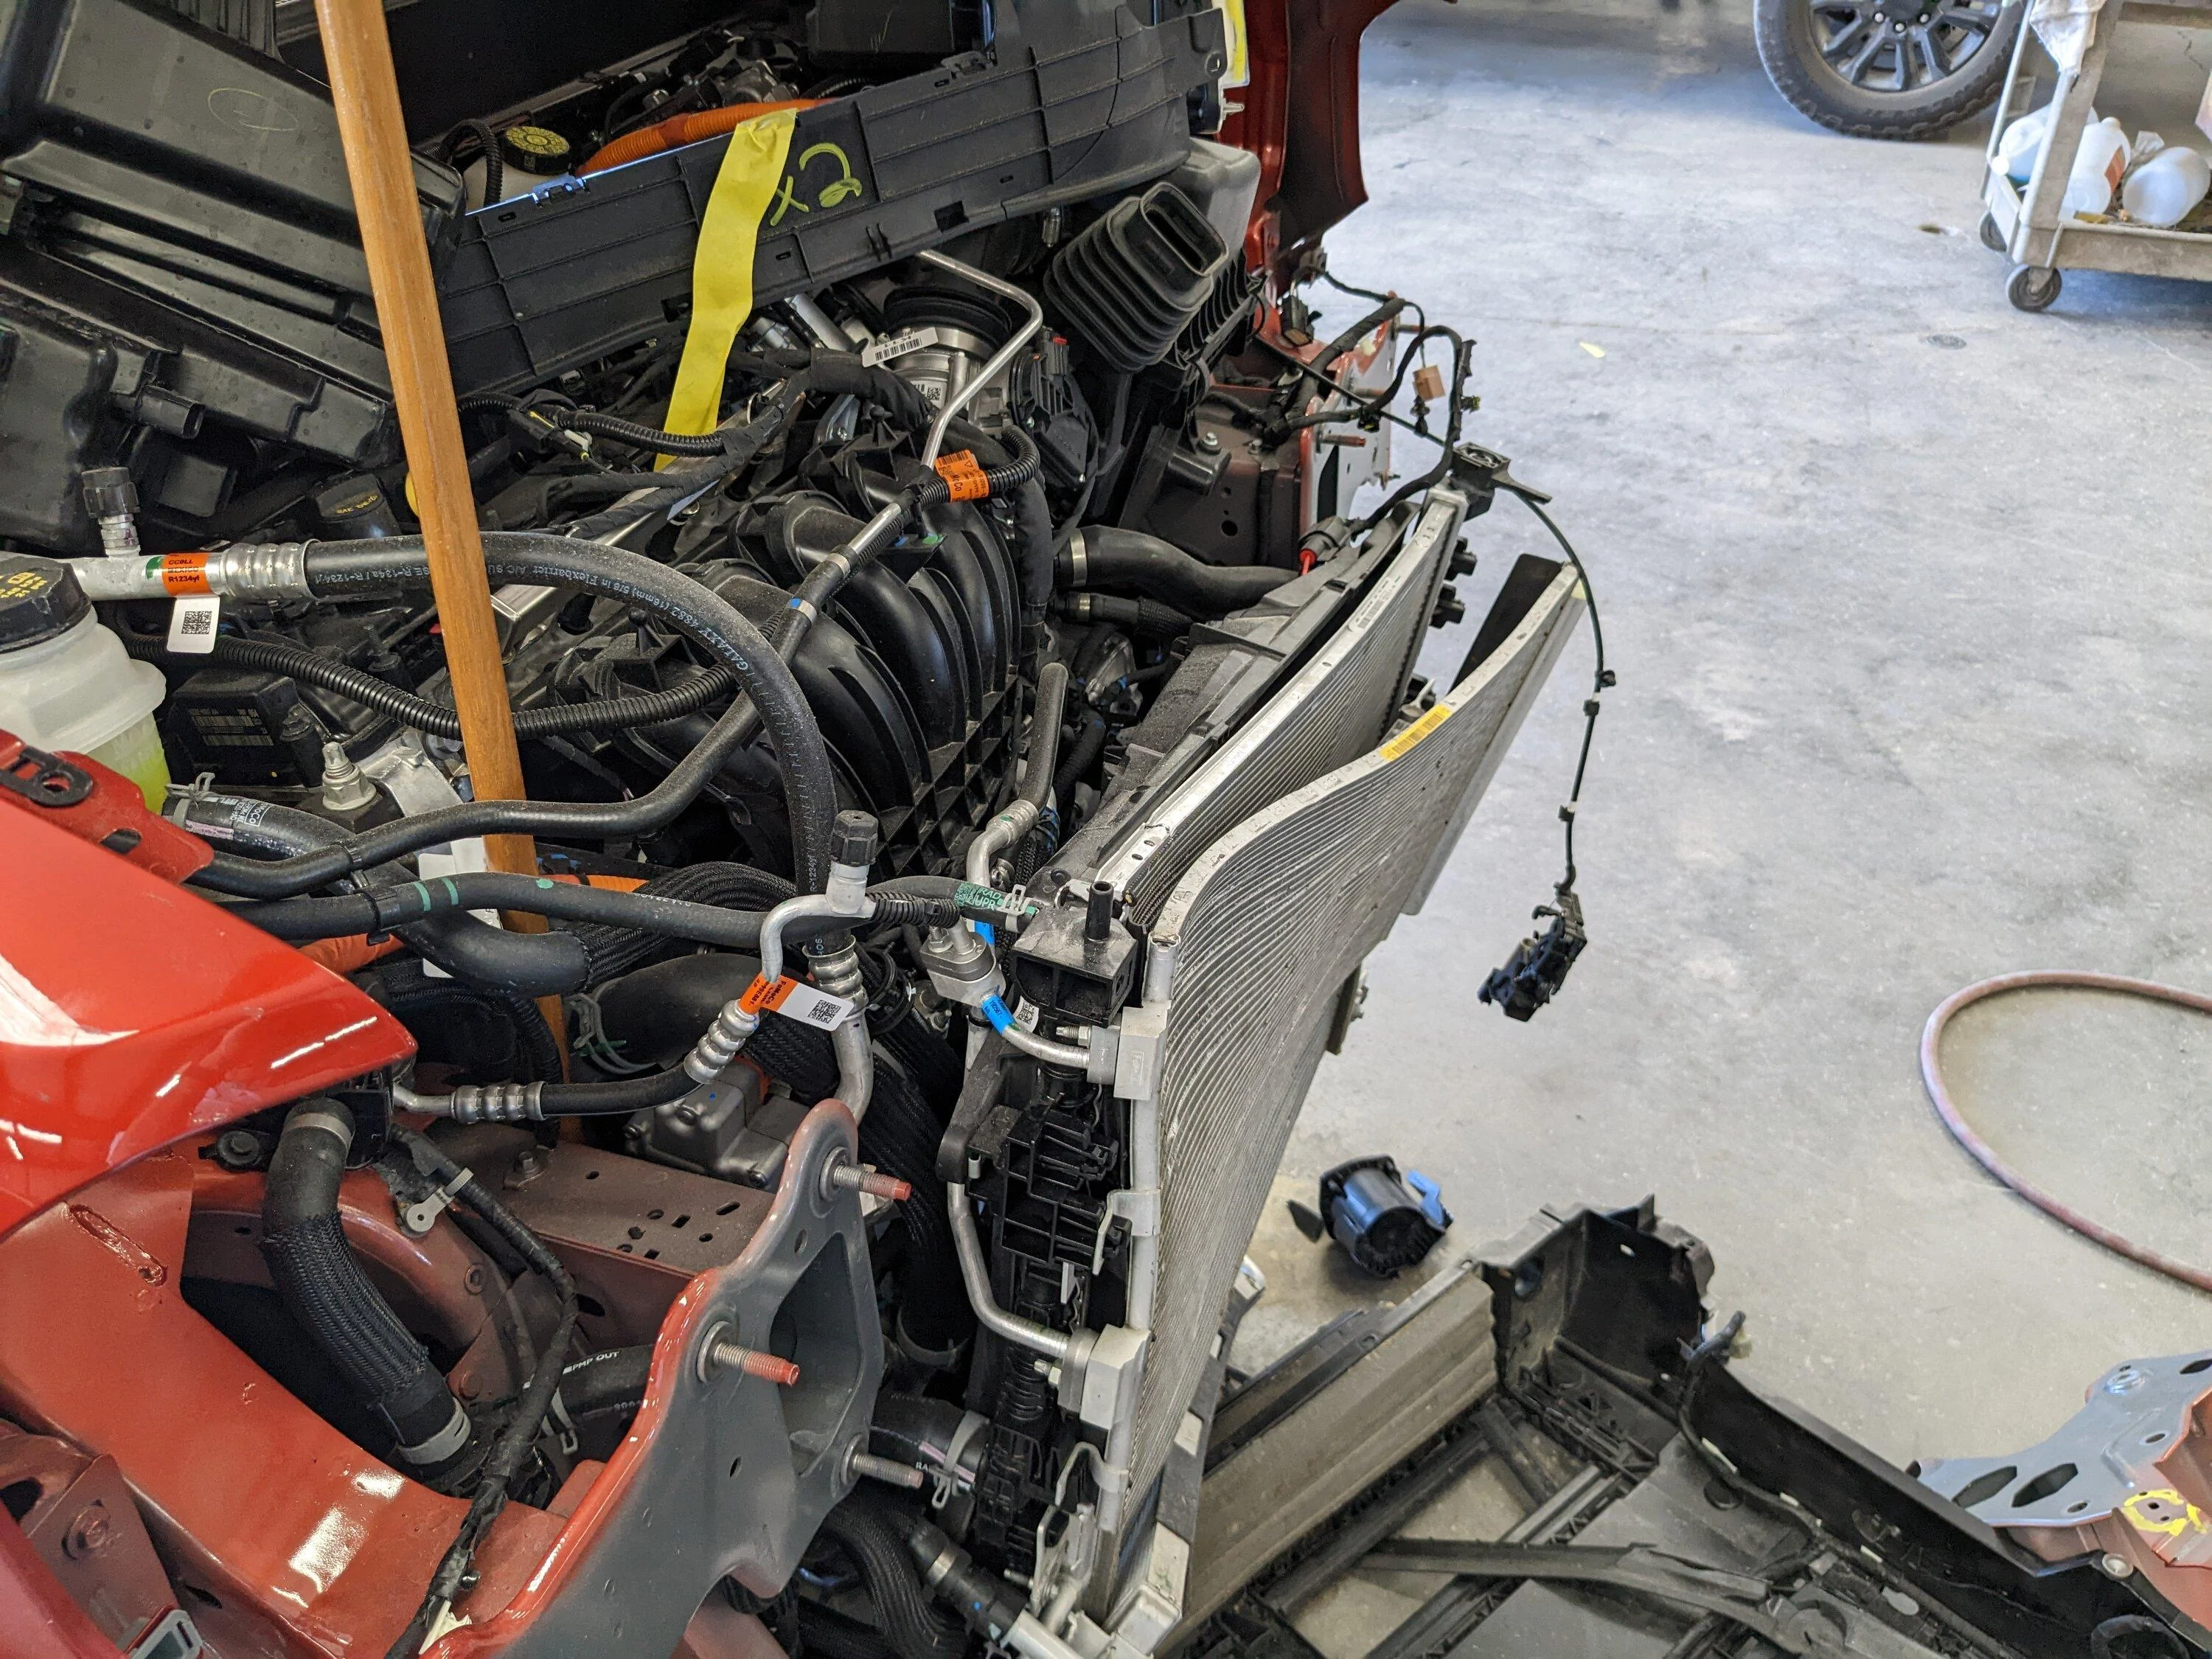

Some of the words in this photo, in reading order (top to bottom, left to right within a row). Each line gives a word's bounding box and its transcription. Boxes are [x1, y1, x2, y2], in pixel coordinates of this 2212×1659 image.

[372, 567, 412, 580] R-134a
[532, 565, 599, 586] Flexbarrier
[669, 607, 699, 627] 4882
[698, 627, 748, 670] GALAXY
[975, 894, 995, 911] UPR
[978, 887, 1002, 900] RAD
[572, 1357, 594, 1371] PMP
[596, 1351, 620, 1361] OUT
